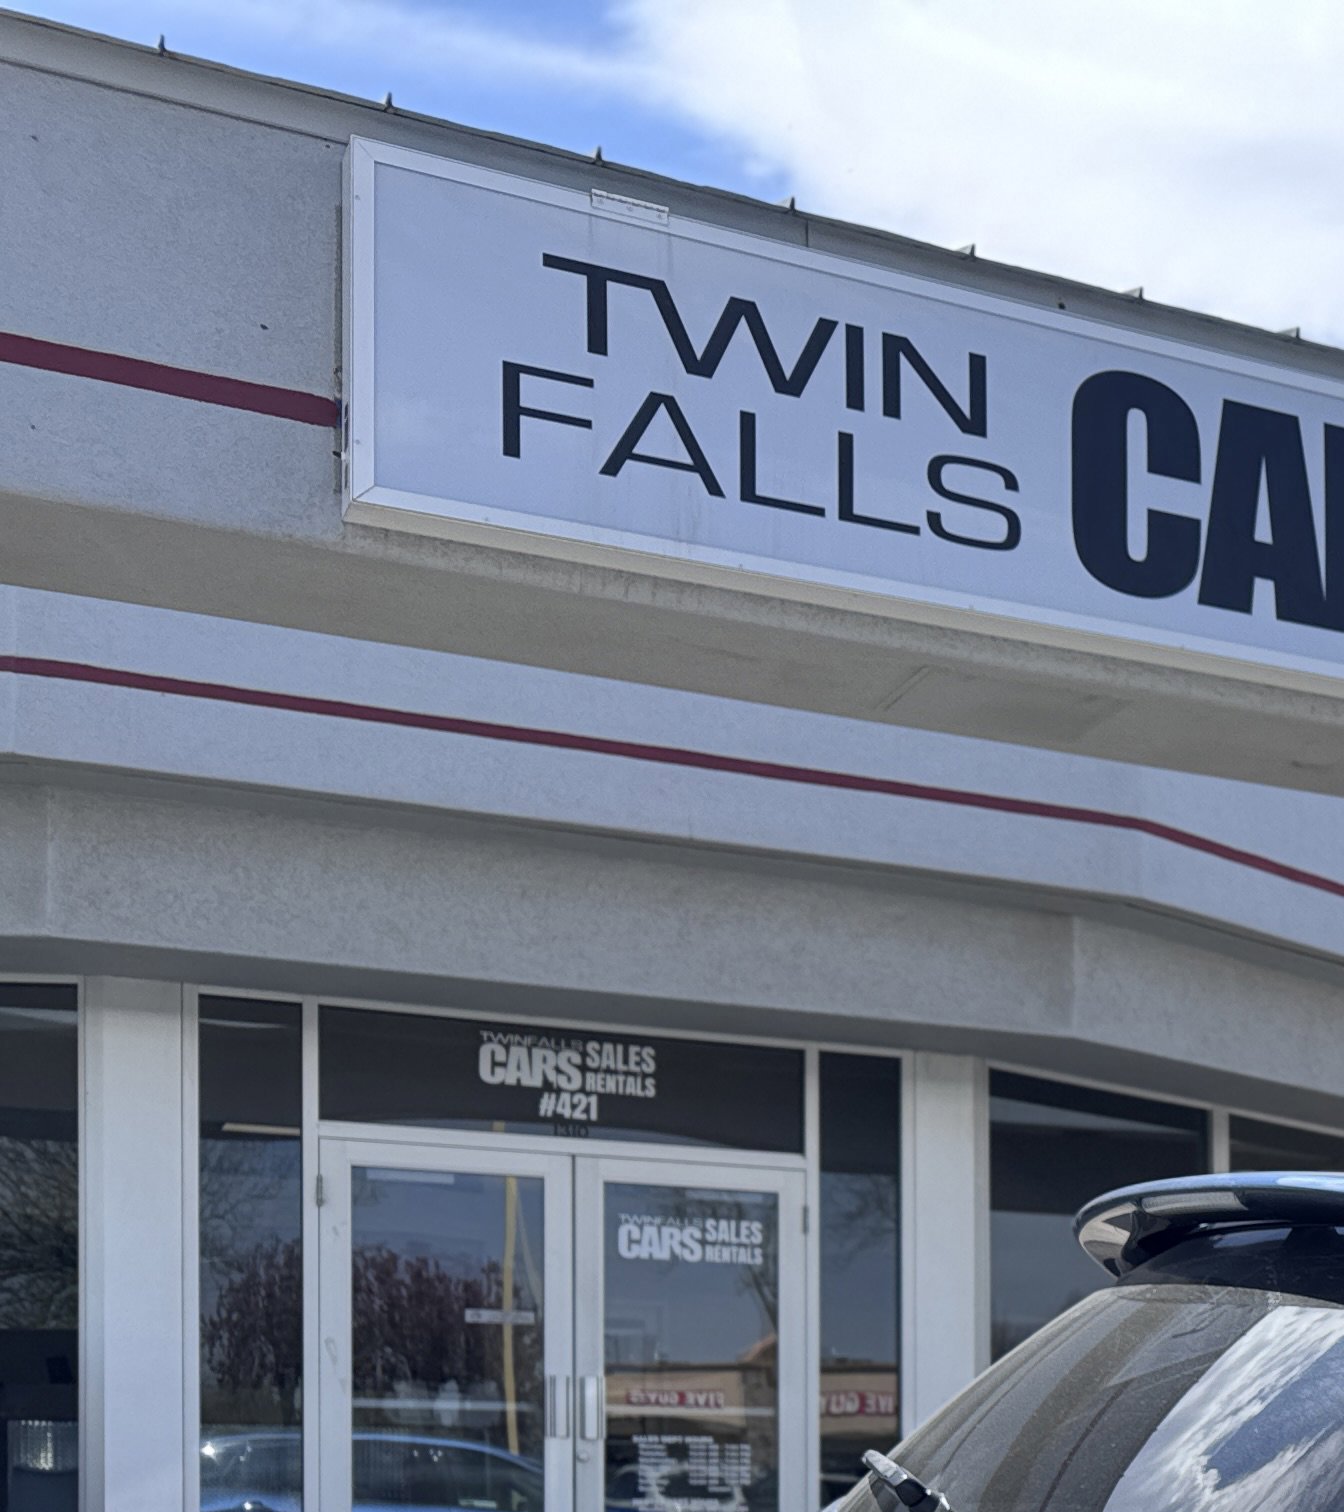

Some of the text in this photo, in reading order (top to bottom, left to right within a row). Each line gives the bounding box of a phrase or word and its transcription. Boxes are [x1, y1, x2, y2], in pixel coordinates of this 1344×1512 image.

[541, 252, 988, 439] TWIN
[500, 359, 1023, 552] FALLS
[478, 1042, 583, 1092] CARS
[585, 1040, 656, 1074] SALES
[585, 1071, 656, 1098] RENTALS
[538, 1092, 599, 1121] #421
[617, 1223, 703, 1263] CARS
[704, 1218, 763, 1245] SALES
[704, 1244, 763, 1265] RENTALS
